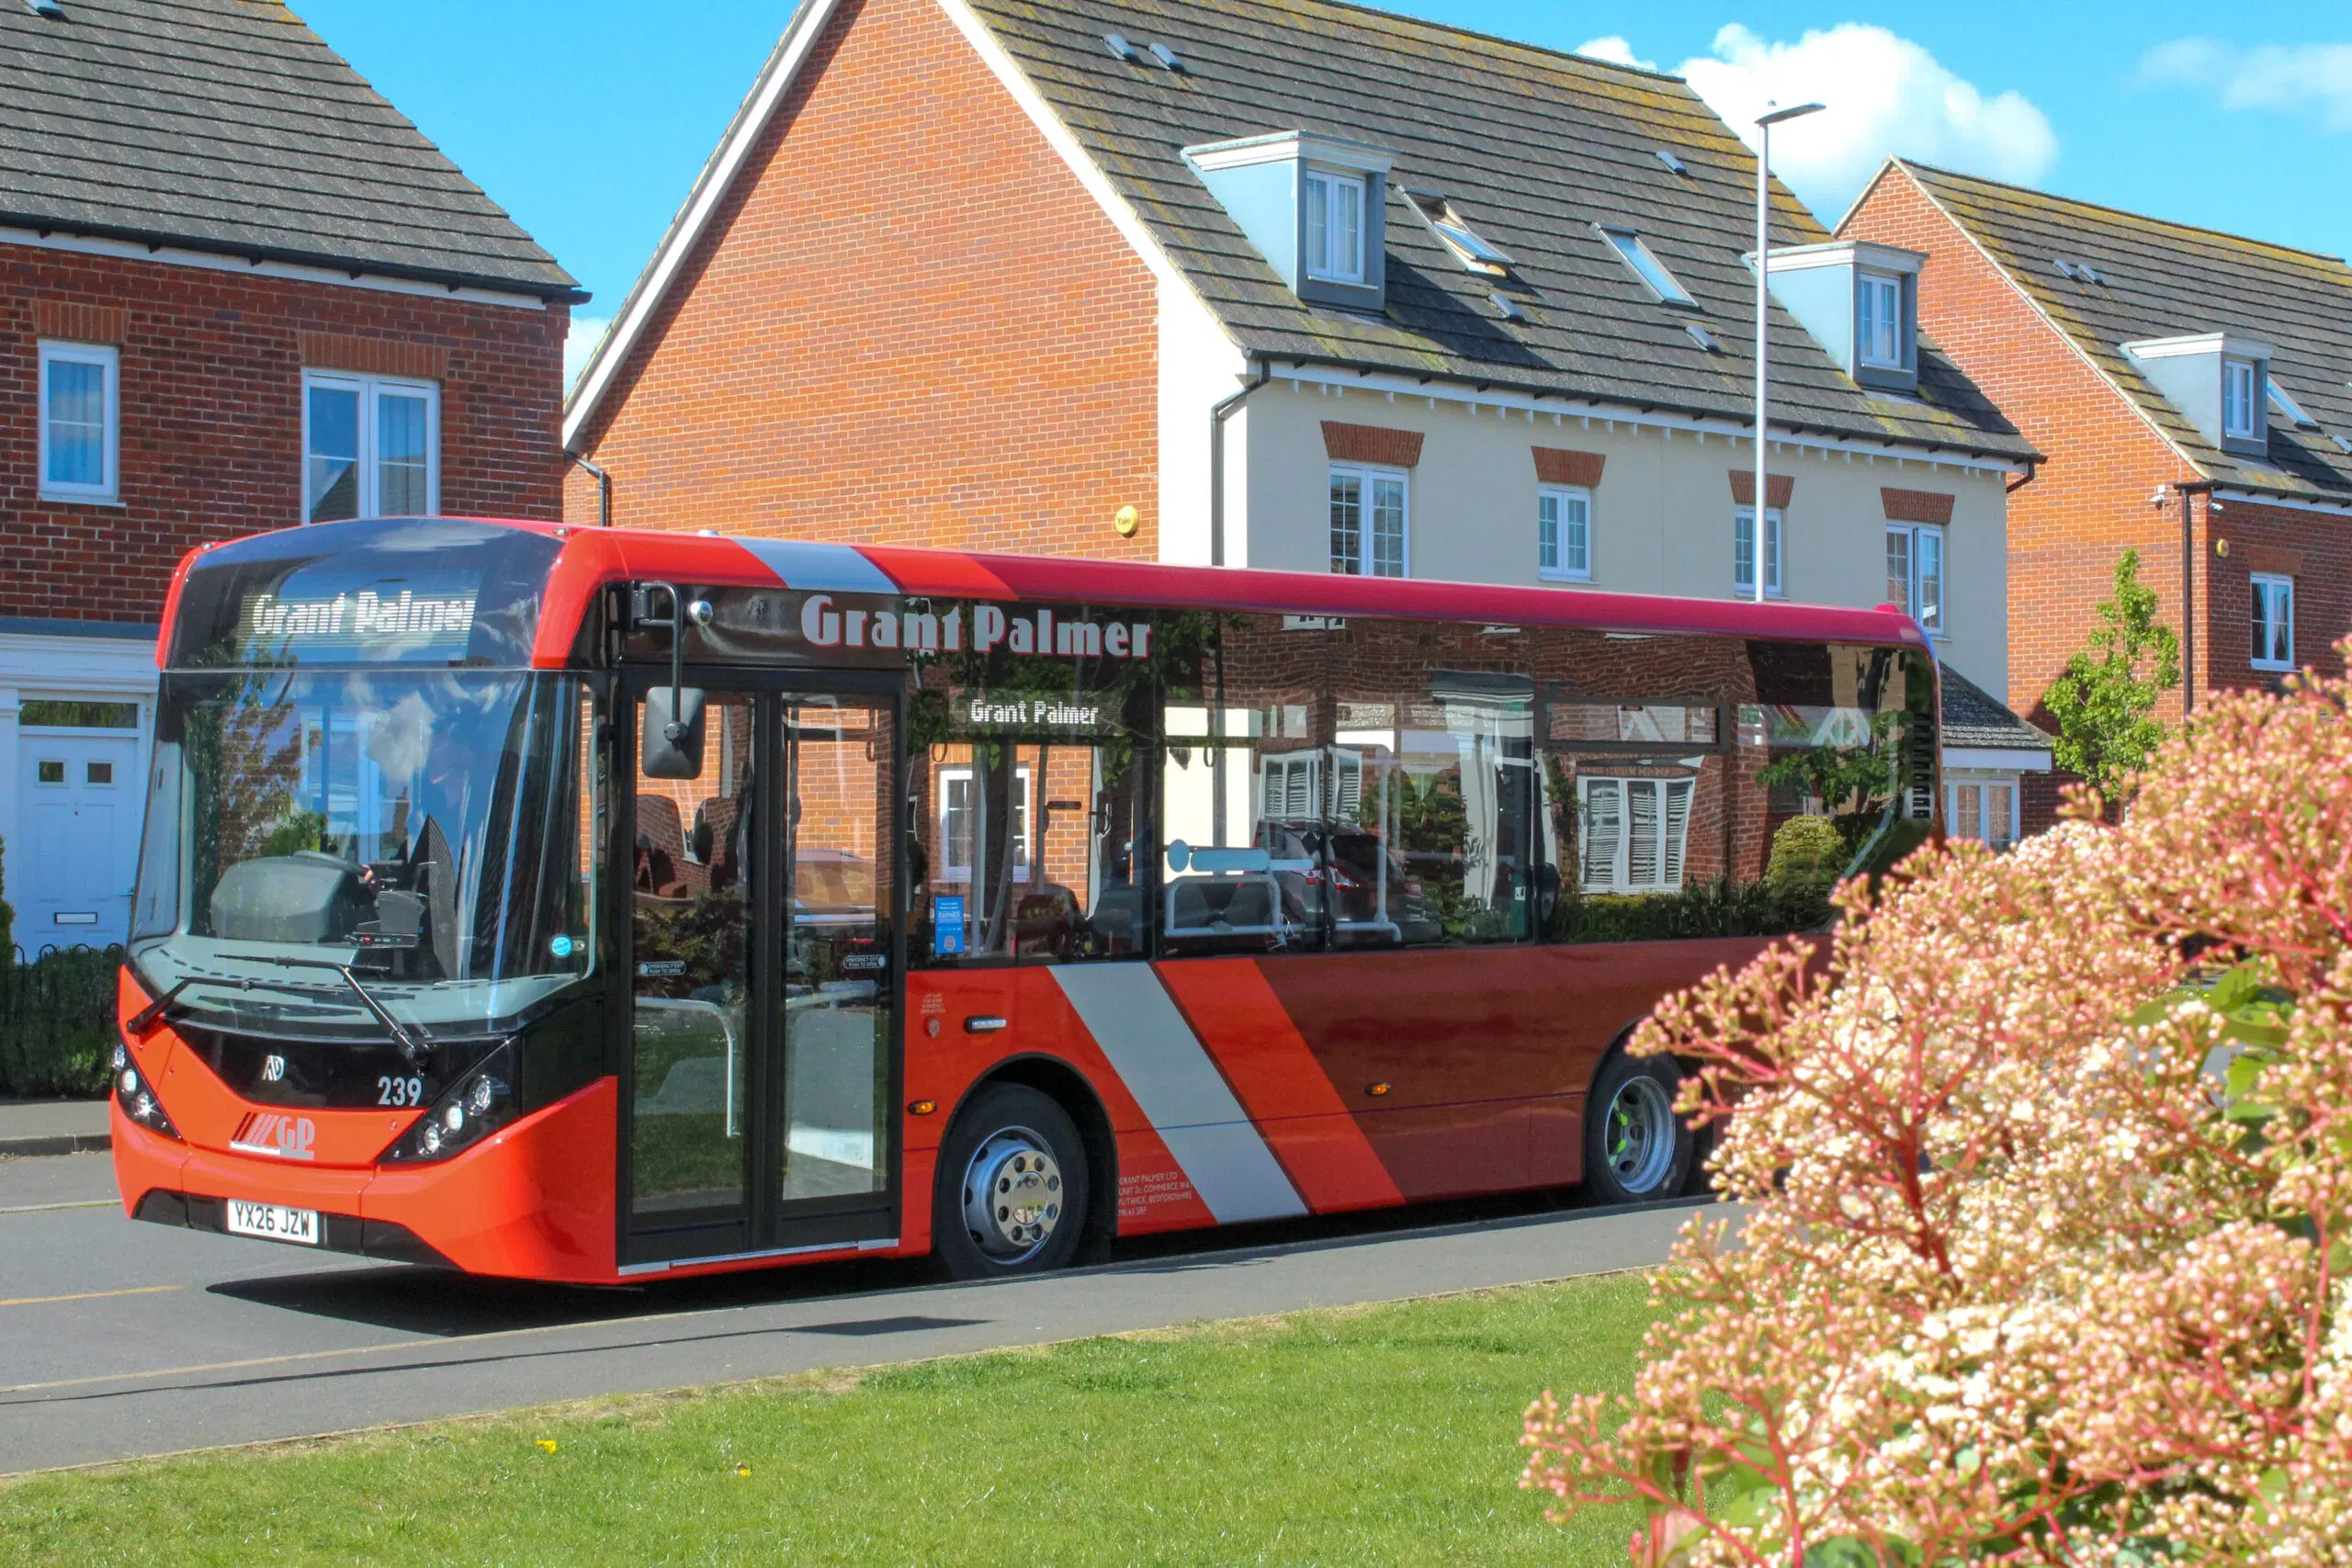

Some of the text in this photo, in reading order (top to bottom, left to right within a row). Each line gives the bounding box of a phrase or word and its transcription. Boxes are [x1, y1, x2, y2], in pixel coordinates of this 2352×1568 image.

[253, 592, 345, 634] Grant
[800, 594, 1150, 659] Grant Palmer
[971, 699, 1099, 725] Grant Palmer
[378, 1077, 423, 1106] 239
[1118, 1187, 1134, 1196] UNIT
[1144, 1182, 1178, 1193] COMMERCE
[1119, 1171, 1178, 1185] GRANT PALMER LTD
[1148, 1190, 1193, 1203] BEDFORDSHIRE
[235, 1202, 310, 1236] YX26 JZW
